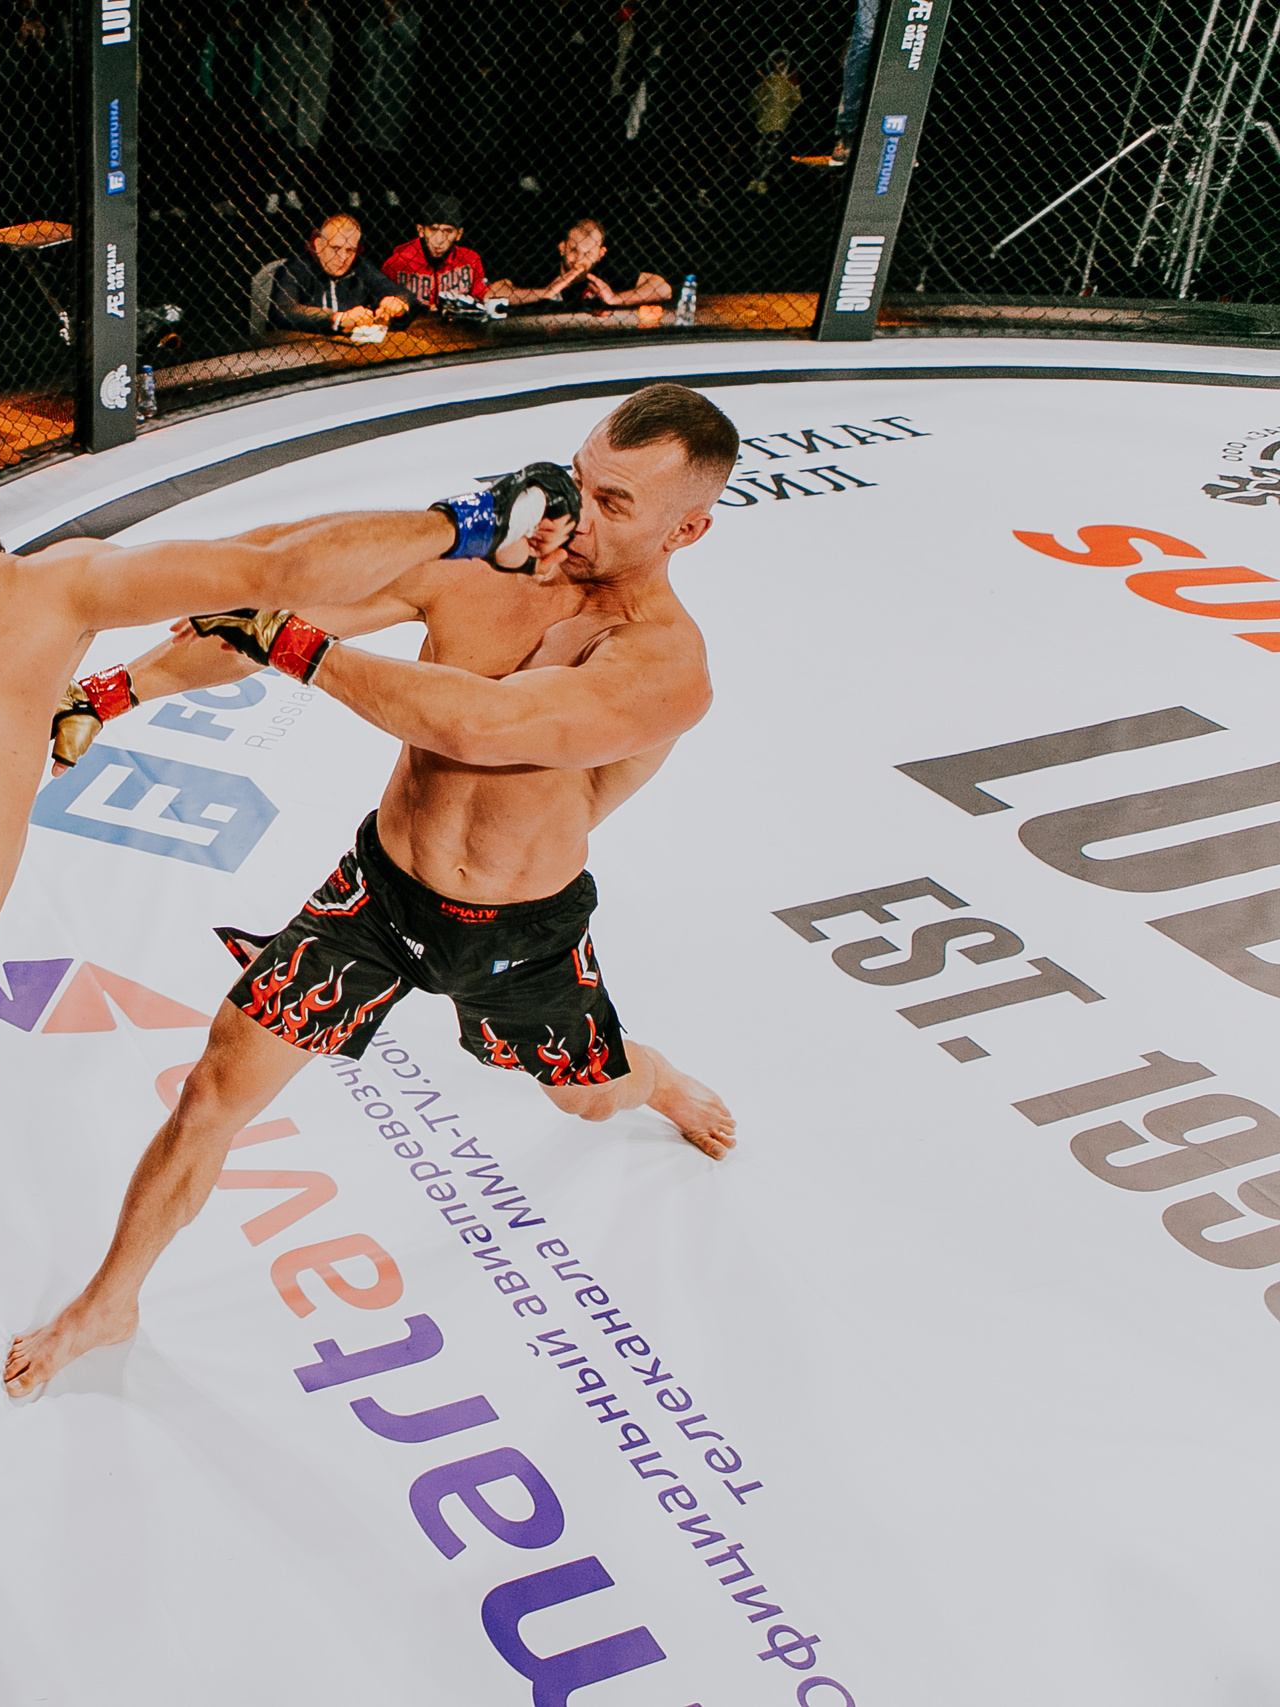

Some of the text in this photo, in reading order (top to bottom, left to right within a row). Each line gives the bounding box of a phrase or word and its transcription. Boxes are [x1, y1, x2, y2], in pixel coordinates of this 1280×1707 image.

[109, 99, 120, 169] FORTUNA
[875, 137, 900, 195] FORTUNA
[835, 235, 886, 313] LUDING
[244, 682, 318, 750] Russia
[771, 877, 1280, 1323] EST. 199
[323, 1054, 548, 1318] авиаперевозчи
[535, 1238, 764, 1506] телеканала
